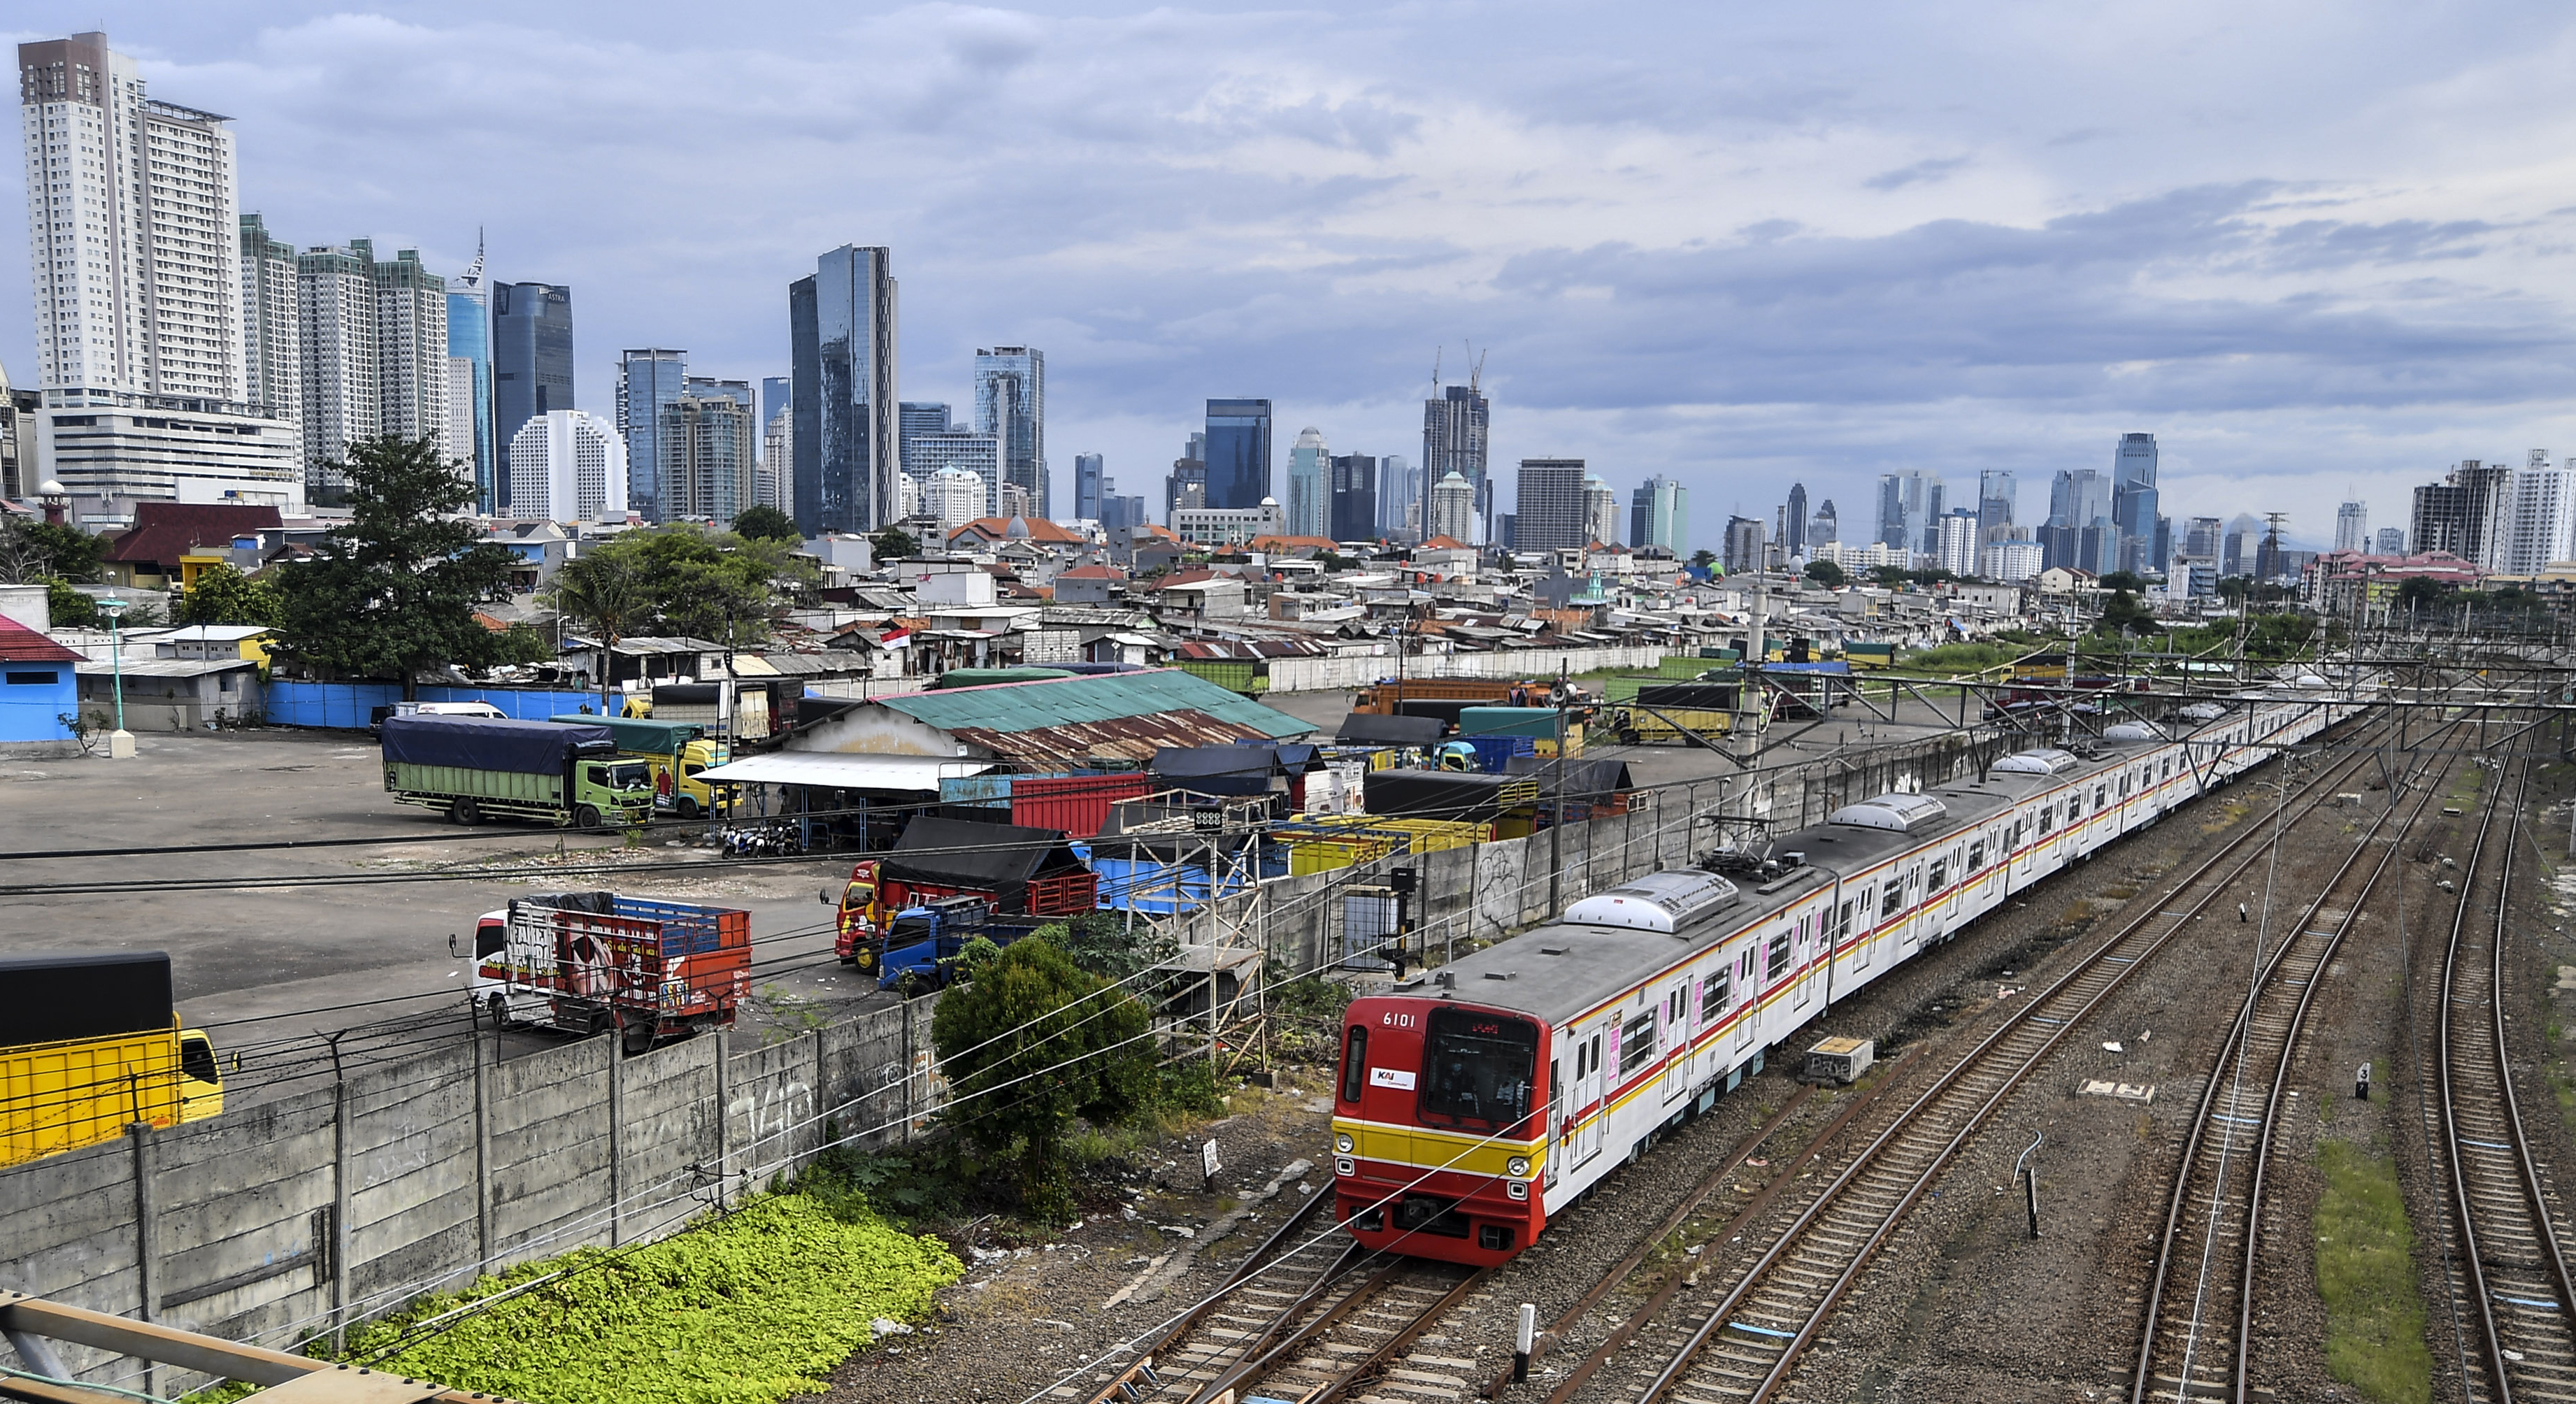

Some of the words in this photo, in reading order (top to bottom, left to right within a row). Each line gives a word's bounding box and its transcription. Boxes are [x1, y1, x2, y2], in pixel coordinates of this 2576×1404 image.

[548, 293, 566, 302] ASTRA
[1383, 1012, 1415, 1028] 6101
[1378, 1070, 1395, 1081] KAI
[2360, 1069, 2368, 1080] 3
